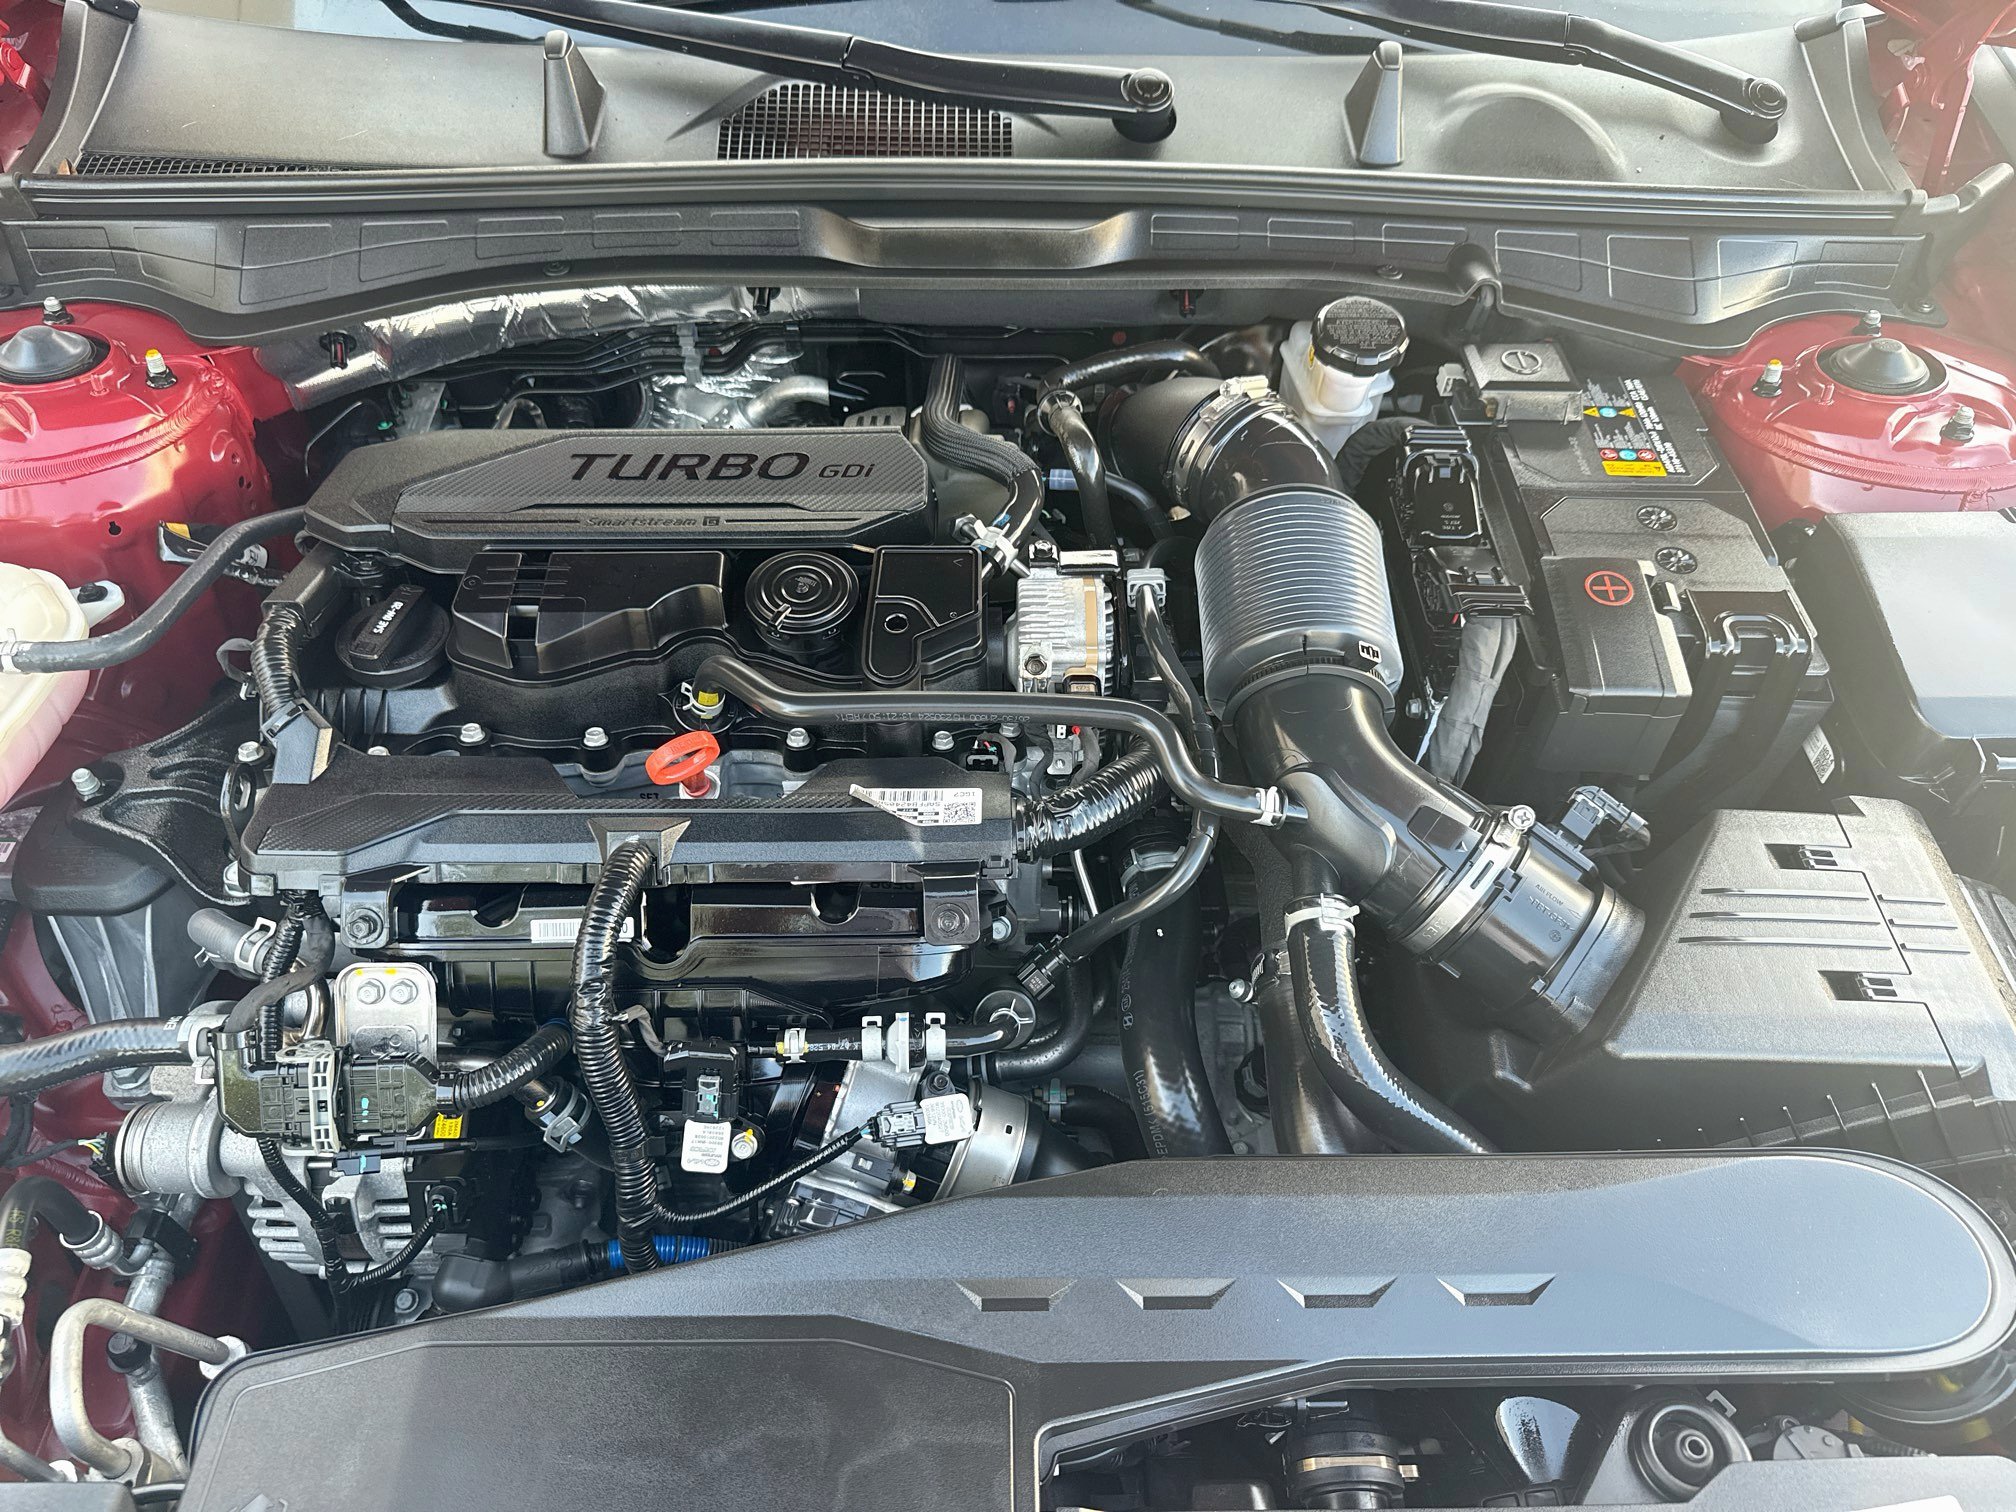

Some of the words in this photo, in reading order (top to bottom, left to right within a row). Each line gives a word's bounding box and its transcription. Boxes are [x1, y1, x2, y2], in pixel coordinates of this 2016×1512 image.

[570, 452, 810, 481] TURBO
[818, 463, 875, 479] GDi
[586, 515, 697, 528] Smartstream
[372, 620, 390, 634] SAE
[382, 601, 404, 621] 0W-20
[1546, 892, 1564, 906] FLOW
[1132, 1069, 1157, 1116] (515C31)
